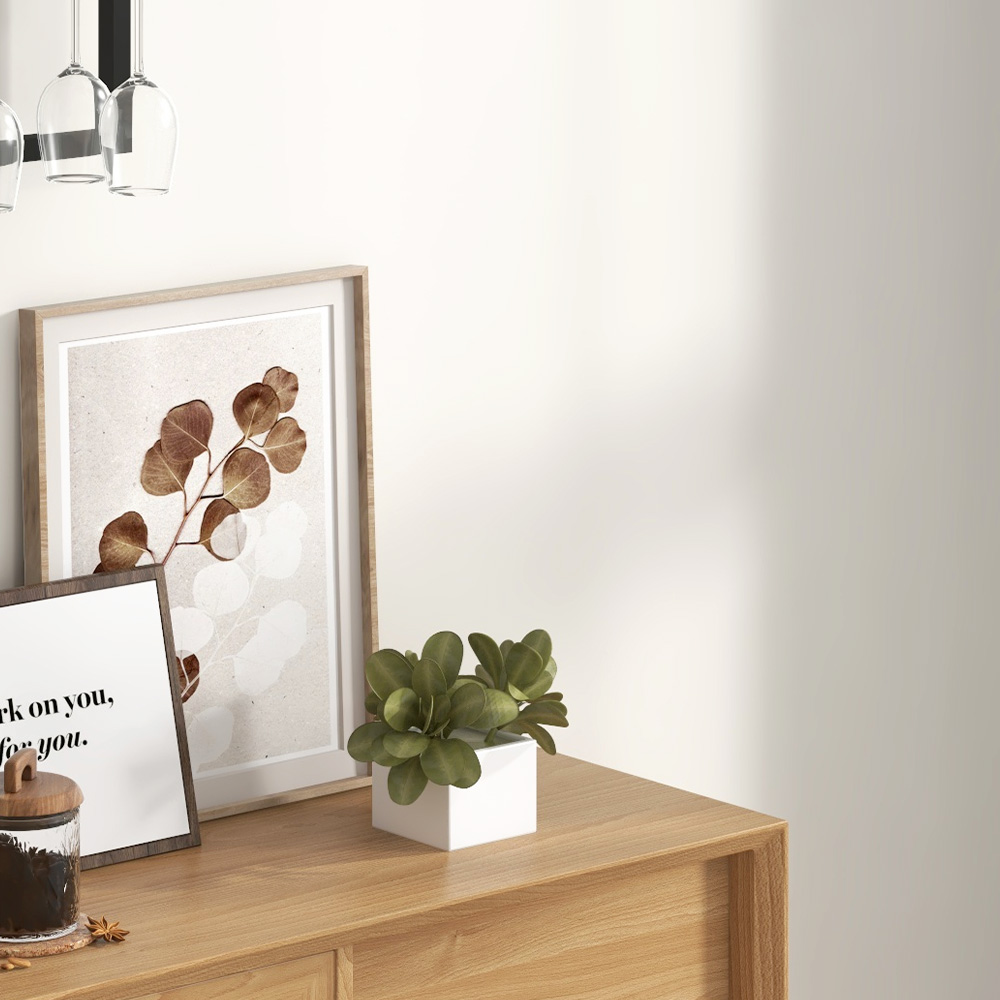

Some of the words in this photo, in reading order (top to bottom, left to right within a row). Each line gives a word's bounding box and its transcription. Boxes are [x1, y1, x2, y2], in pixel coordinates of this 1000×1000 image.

[28, 698, 59, 719] on
[63, 688, 114, 718] you,
[37, 731, 88, 761] you.
